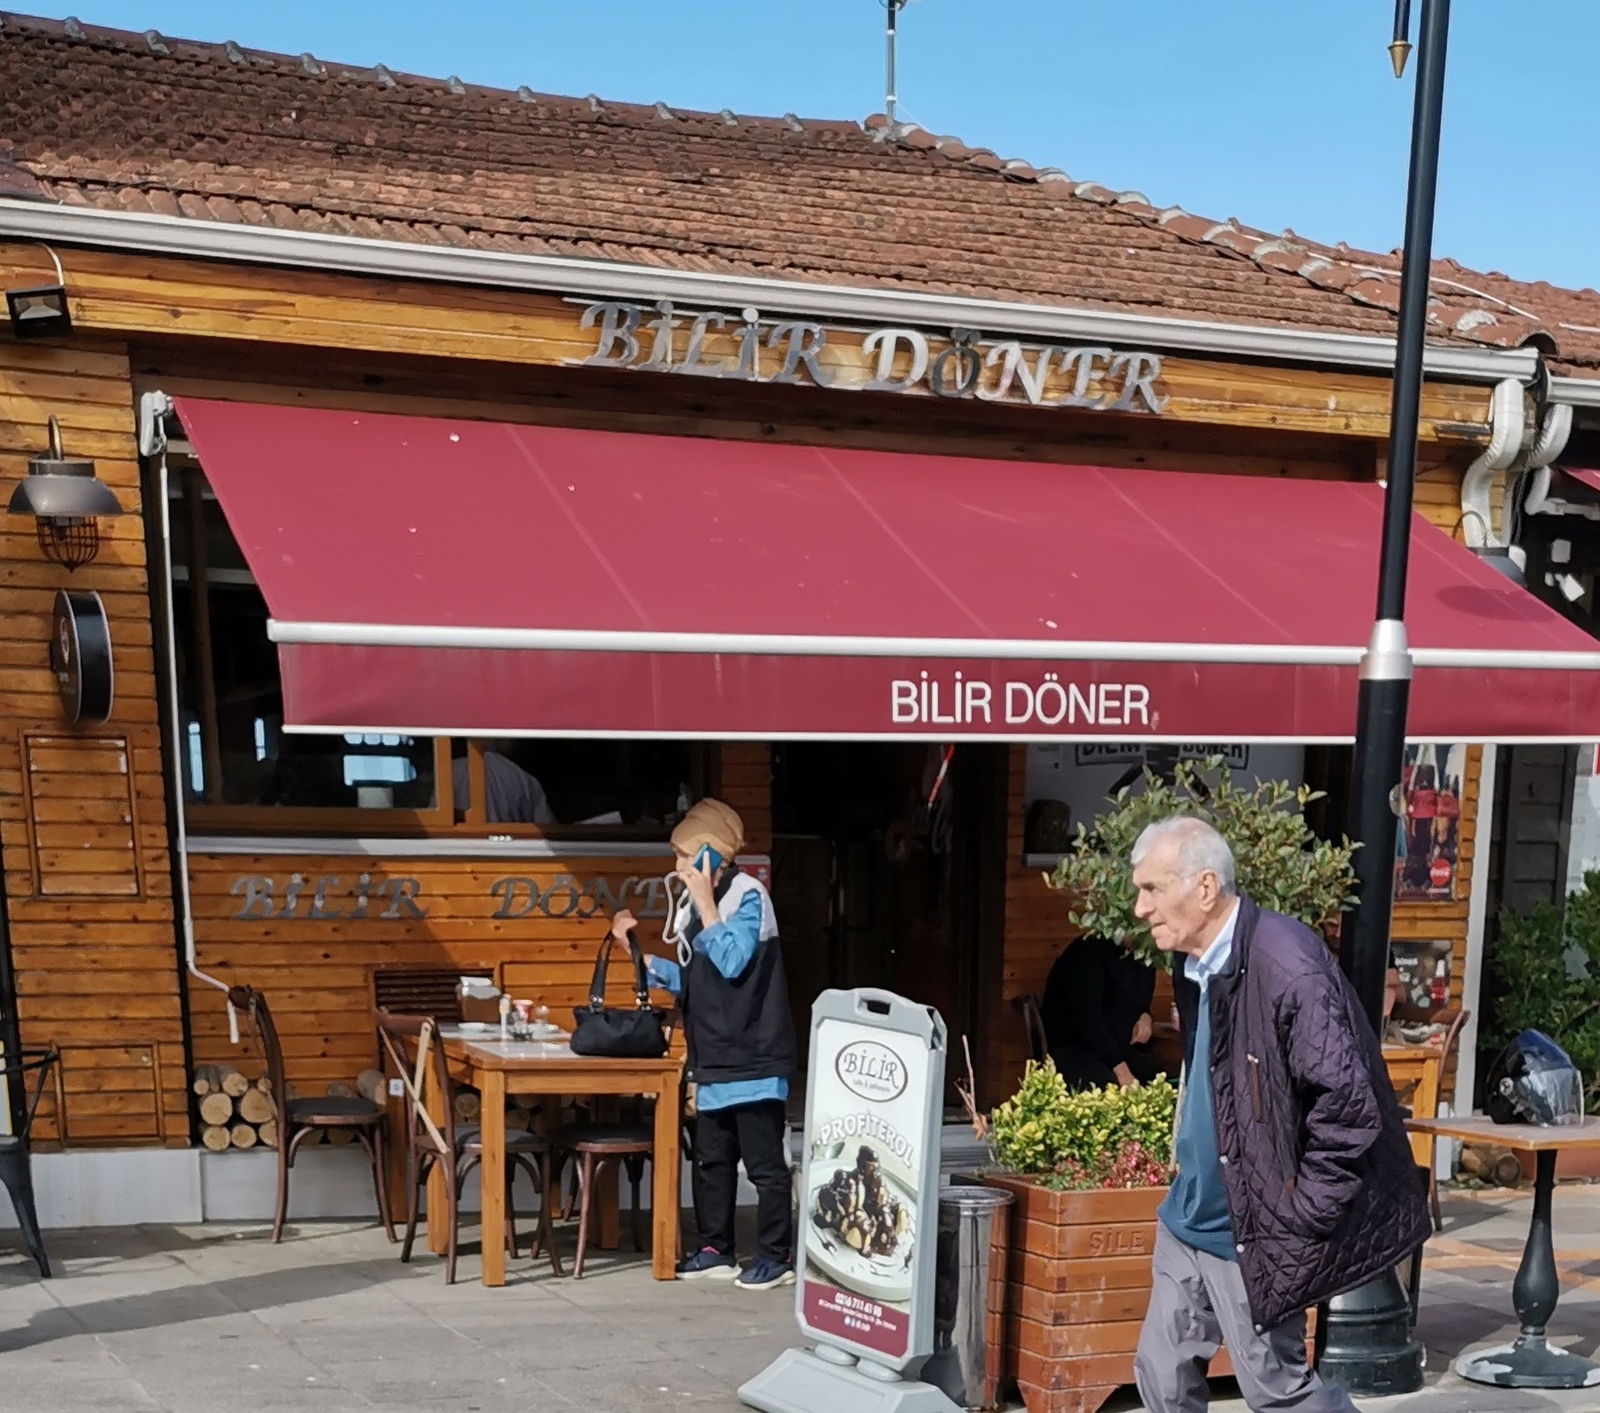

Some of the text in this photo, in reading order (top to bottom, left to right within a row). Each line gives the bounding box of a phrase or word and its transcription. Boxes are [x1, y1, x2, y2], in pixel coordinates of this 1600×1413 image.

[580, 300, 1169, 414] BİLİR DÖNER
[891, 670, 1150, 725] BİLİR DÖNER
[230, 872, 685, 920] BİLİR DÖNE
[843, 1048, 899, 1089] BİLİR
[820, 1109, 914, 1168] PROFİTEROL
